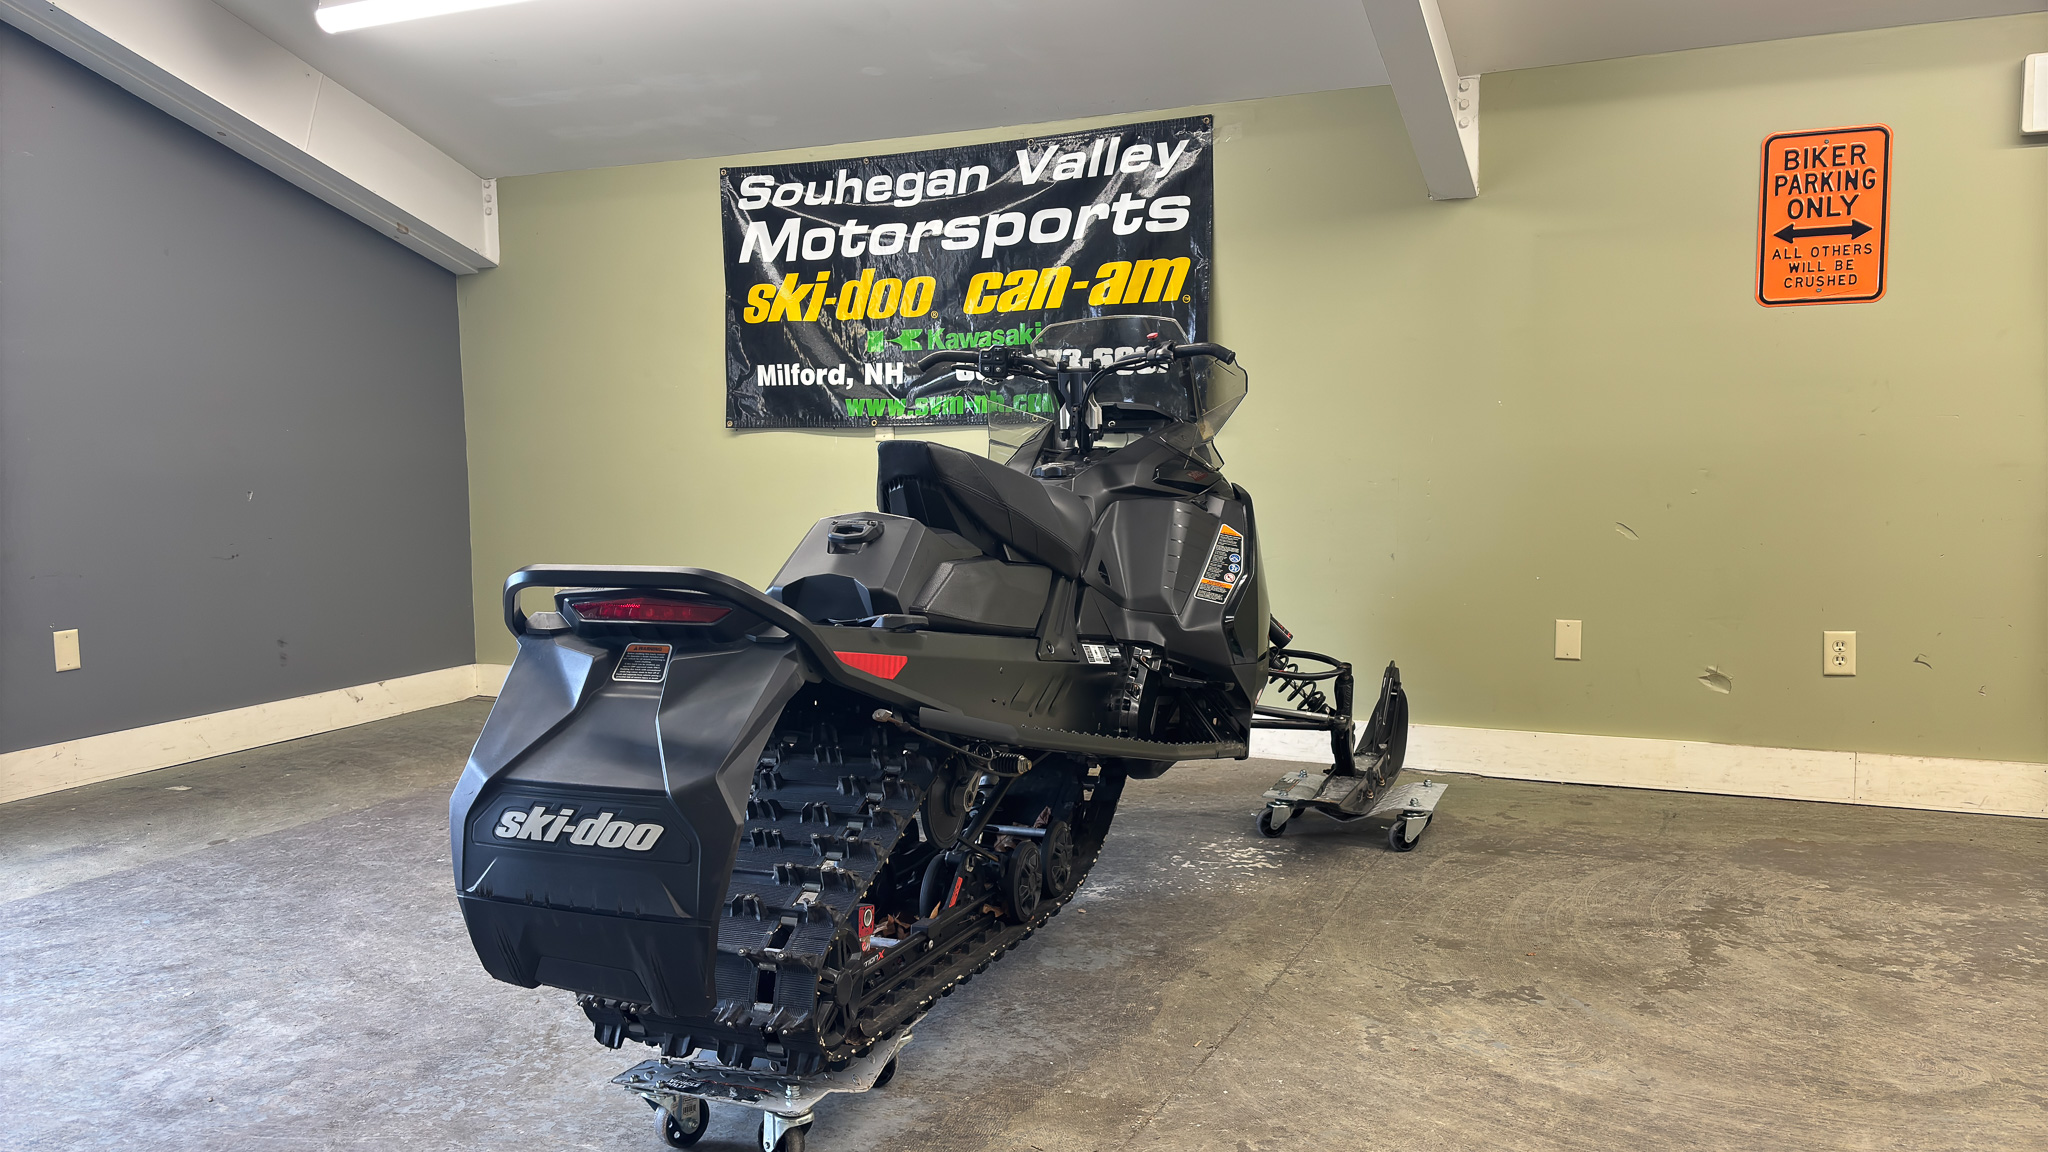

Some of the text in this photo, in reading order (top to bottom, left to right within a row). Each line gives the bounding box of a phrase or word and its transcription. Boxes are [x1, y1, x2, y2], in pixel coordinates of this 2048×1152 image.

[1784, 144, 1867, 171] BIKER
[738, 135, 1190, 211] Souhegan Valley
[1774, 168, 1877, 196] PARKING
[1787, 194, 1860, 220] ONLY
[738, 192, 1191, 264] Motorsports
[1772, 243, 1873, 260] ALL OTHERS
[1788, 259, 1854, 273] WILL BE
[743, 256, 1191, 324] ski-doo can-am
[1784, 274, 1858, 288] CRUSHED
[927, 321, 1042, 350] Kawasaki
[757, 361, 904, 390] Milford, NH
[495, 806, 665, 851] ski-doo
